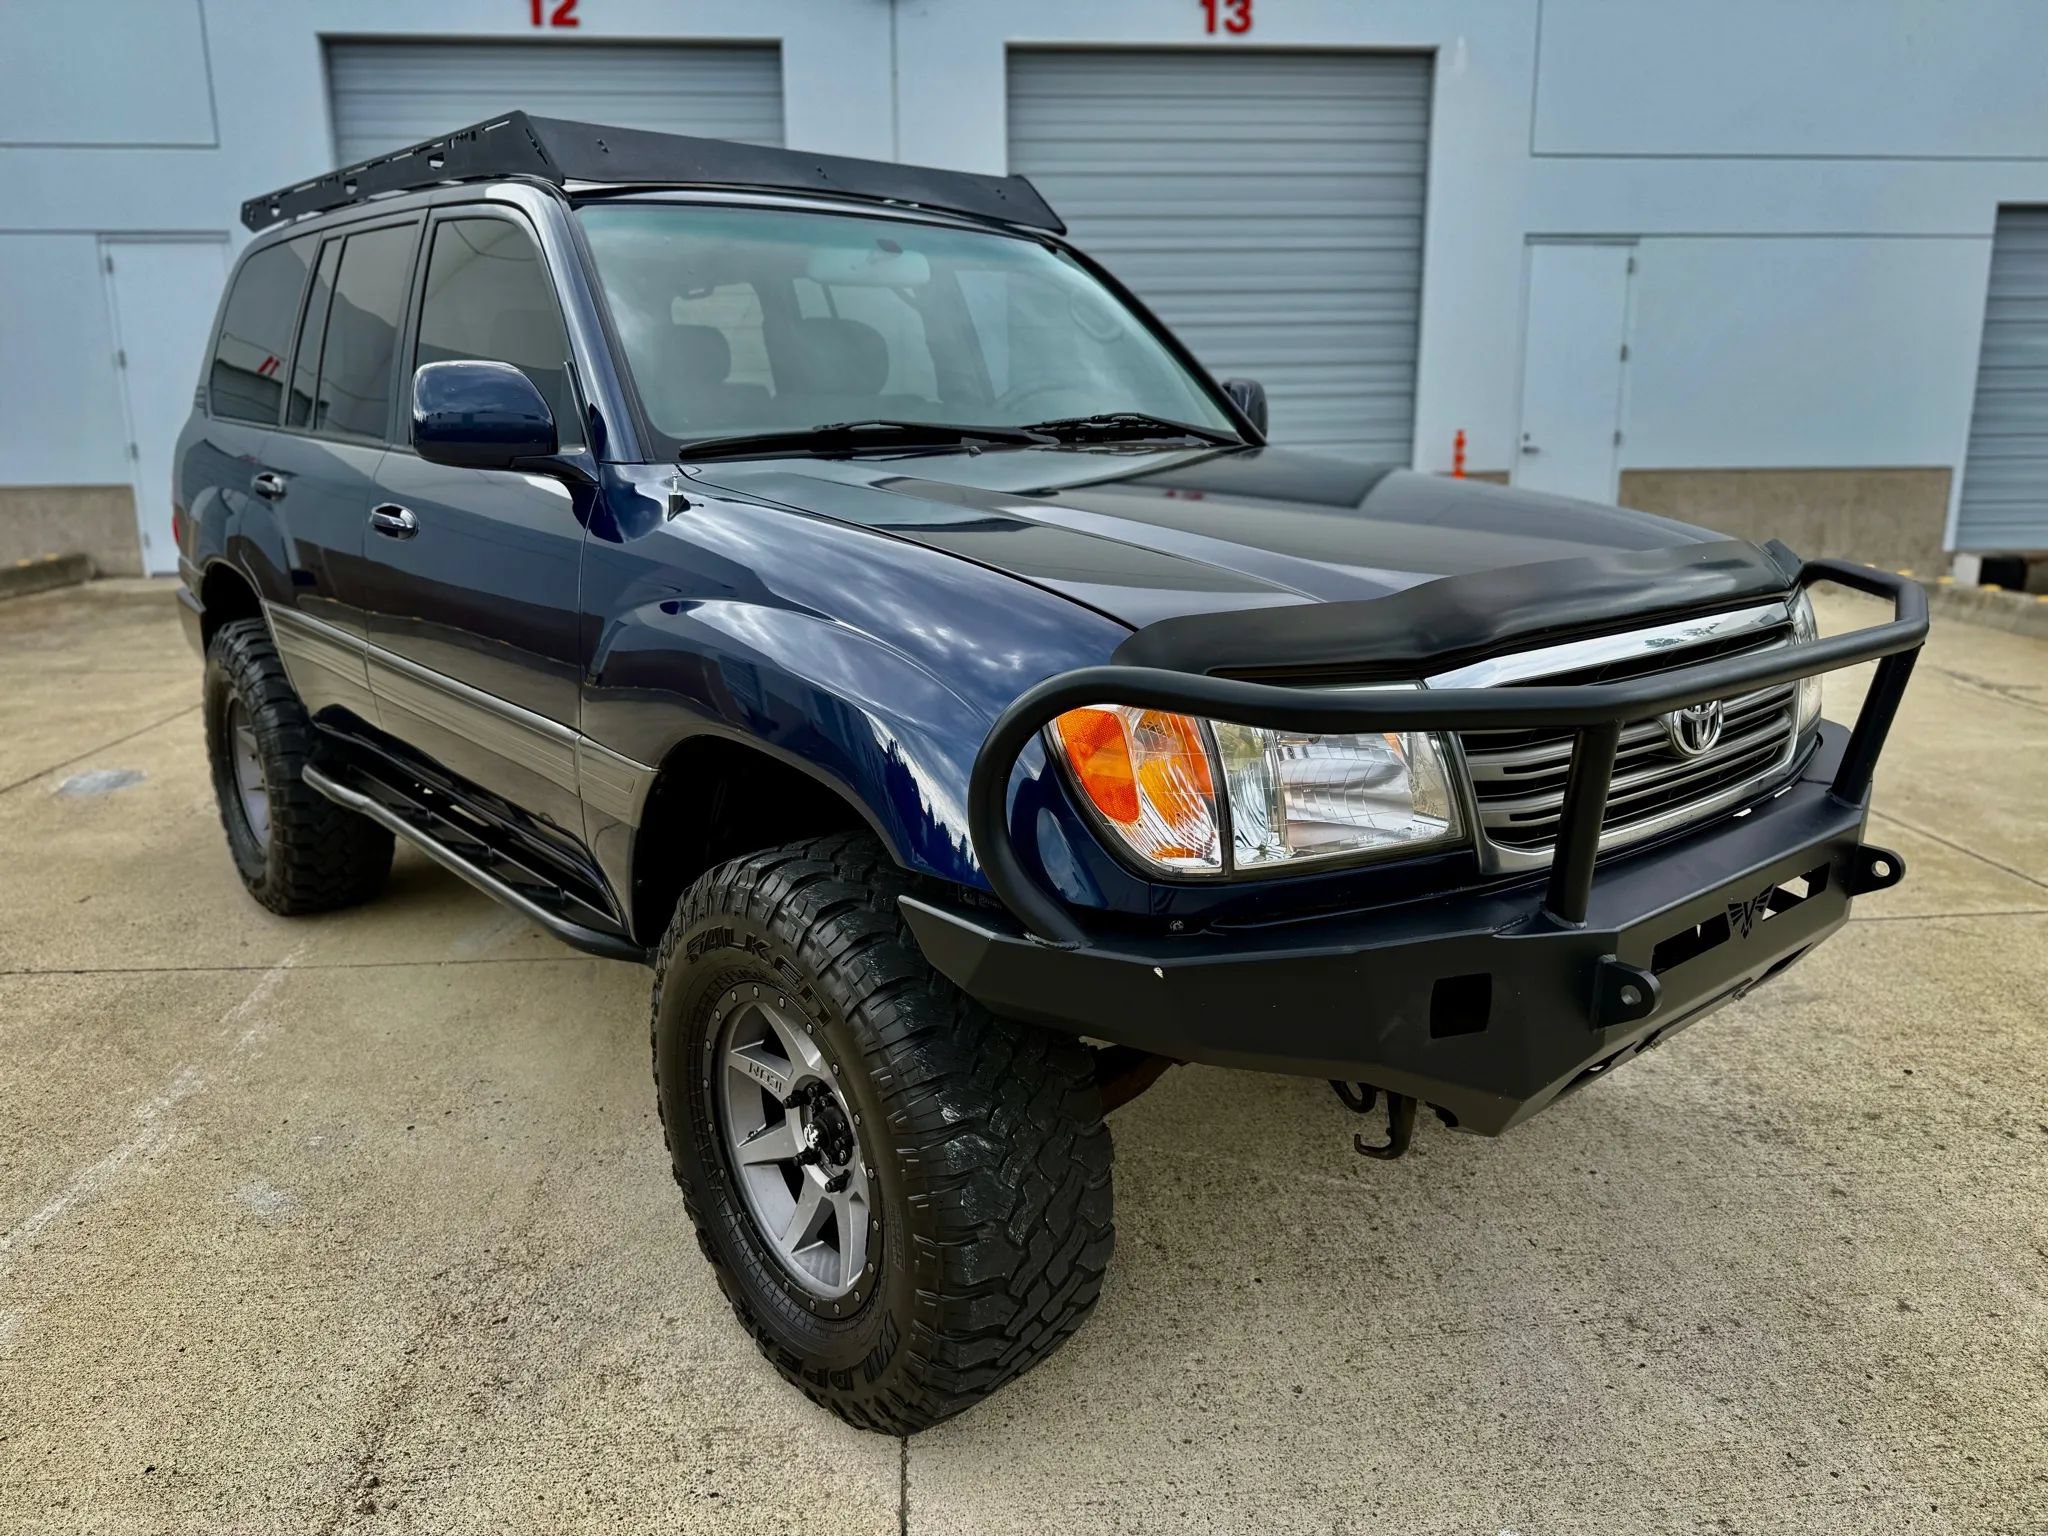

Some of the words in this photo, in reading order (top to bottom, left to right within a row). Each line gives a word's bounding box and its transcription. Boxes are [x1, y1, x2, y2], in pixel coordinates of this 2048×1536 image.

[530, 0, 580, 28] 12
[1200, 0, 1253, 34] 13
[687, 927, 832, 1027] FALKEN
[749, 1062, 783, 1092] ICON
